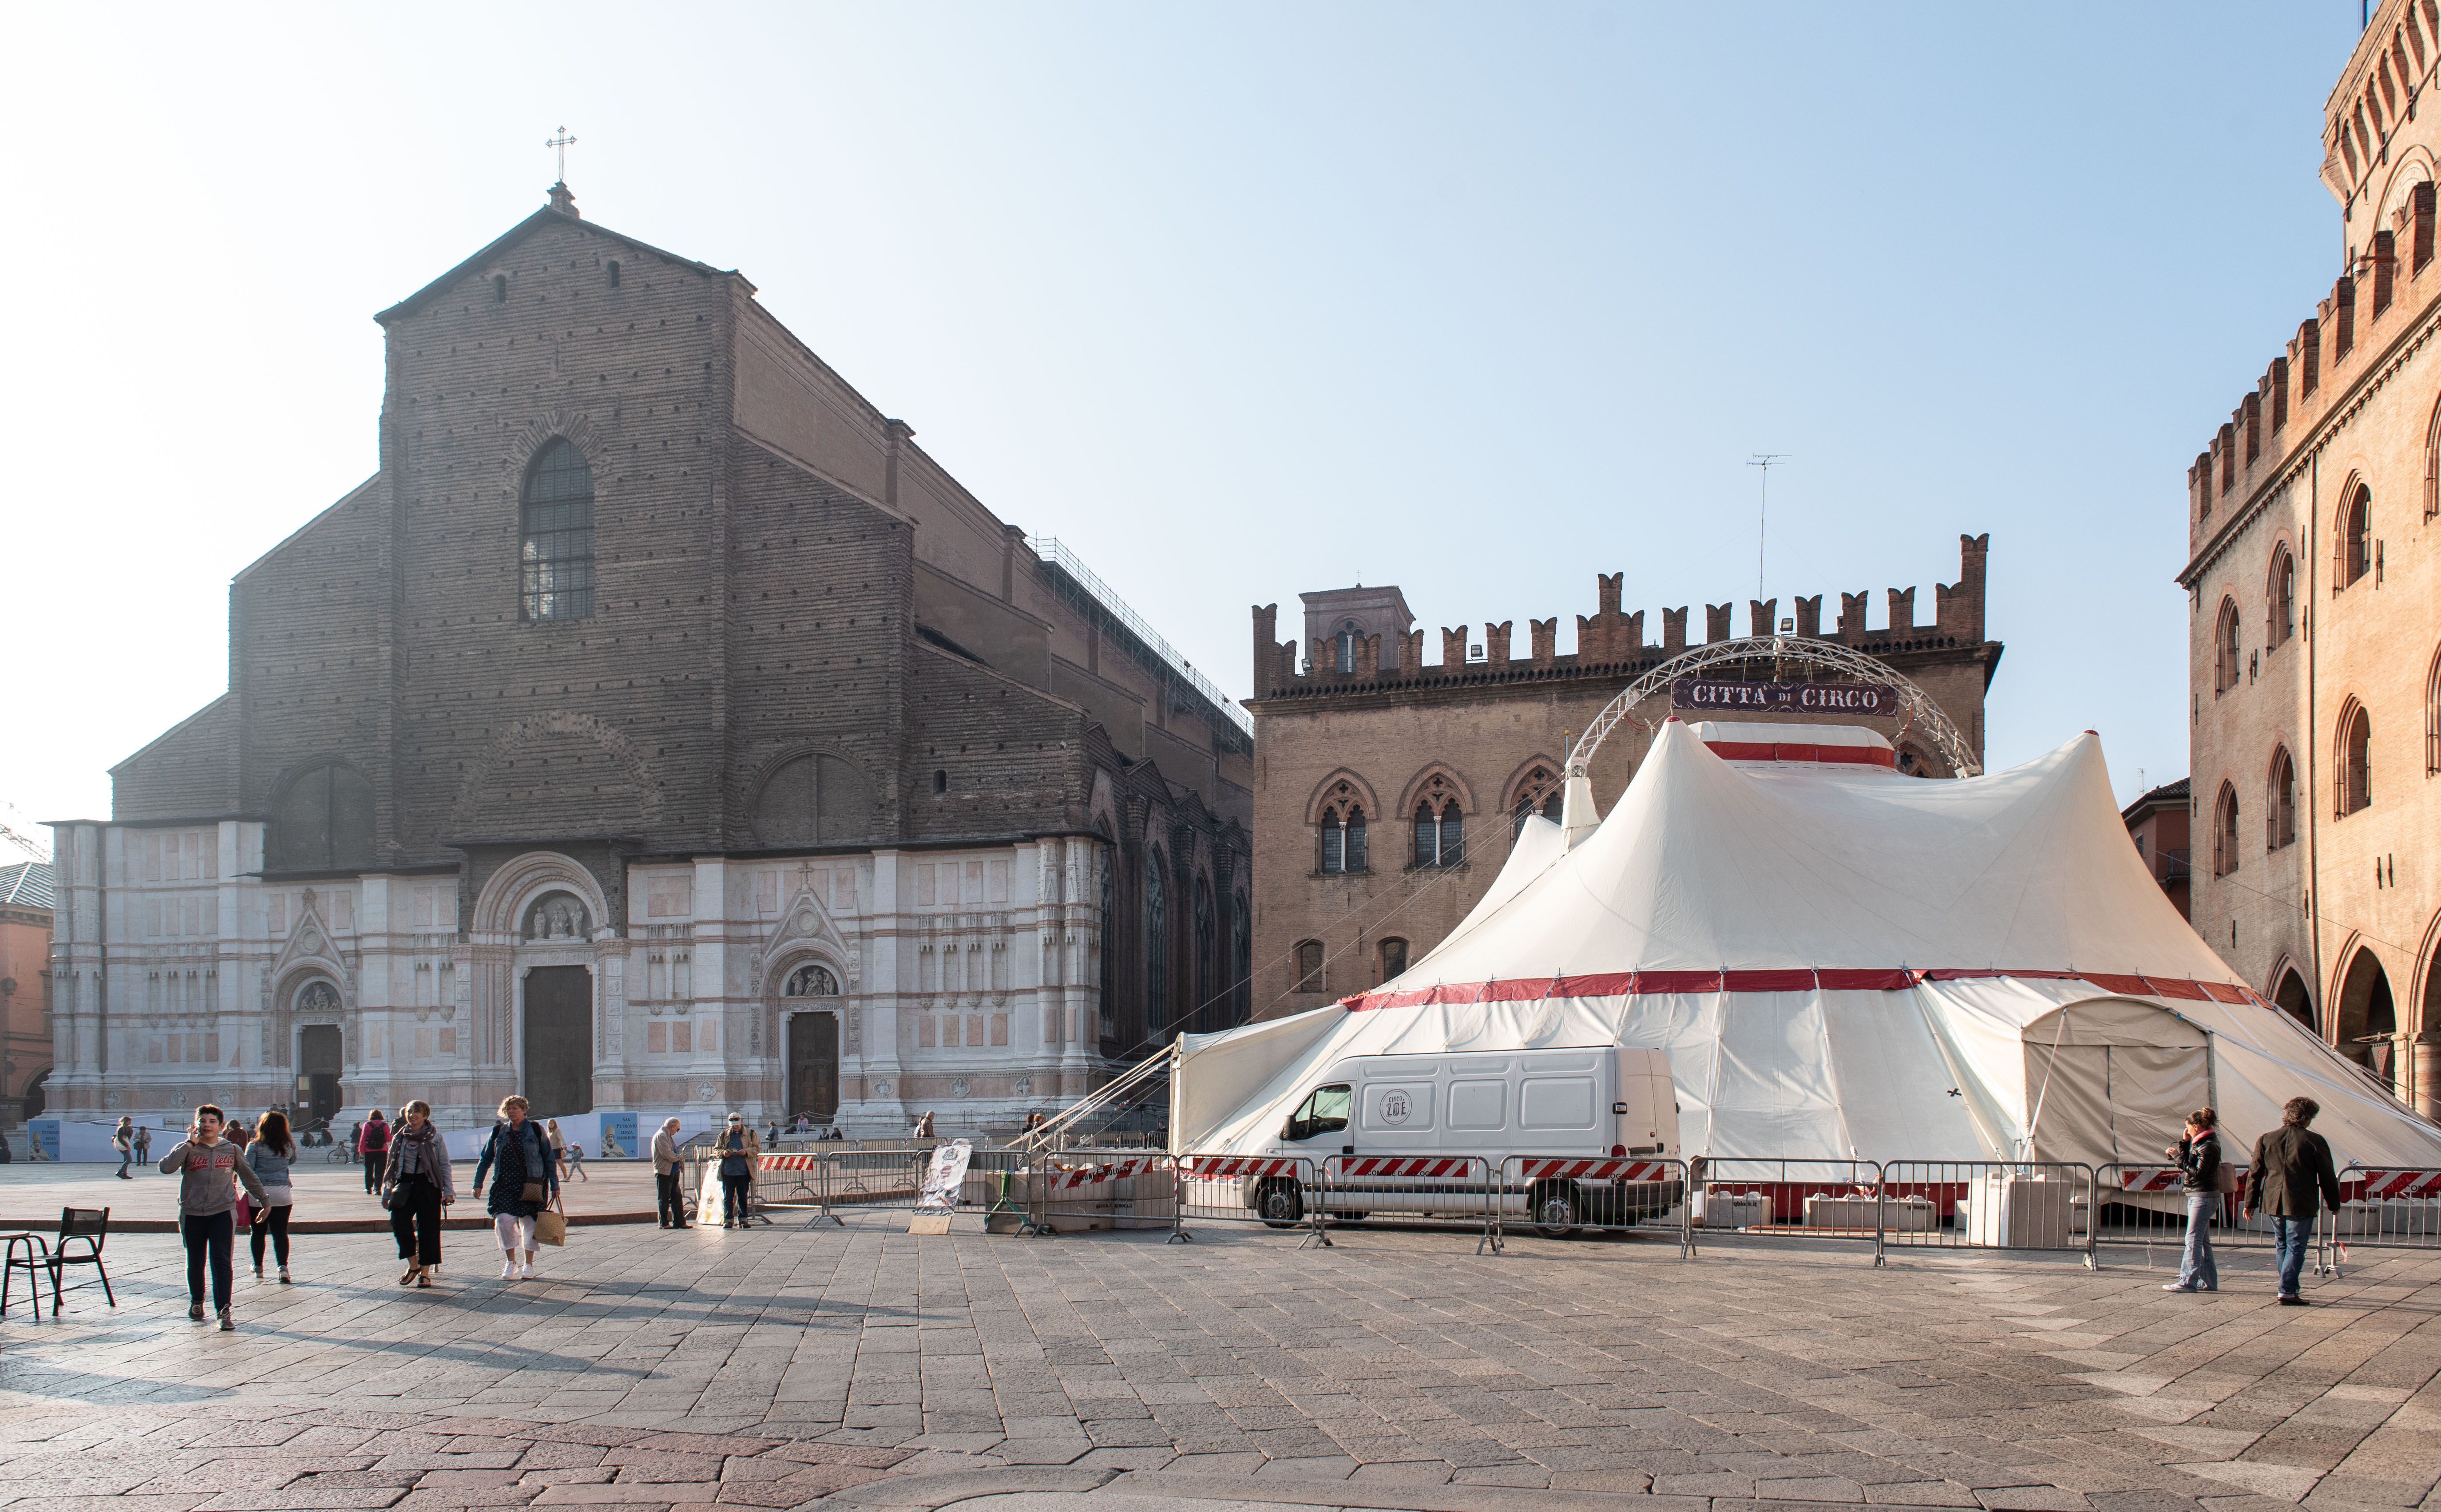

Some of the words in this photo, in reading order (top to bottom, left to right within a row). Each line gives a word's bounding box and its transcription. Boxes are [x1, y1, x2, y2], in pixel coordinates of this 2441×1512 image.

[1778, 693, 1791, 701] DI
[1801, 689, 1878, 708] CIRCO
[187, 1154, 234, 1167] Athletic
[2155, 1176, 2182, 1185] COMU
